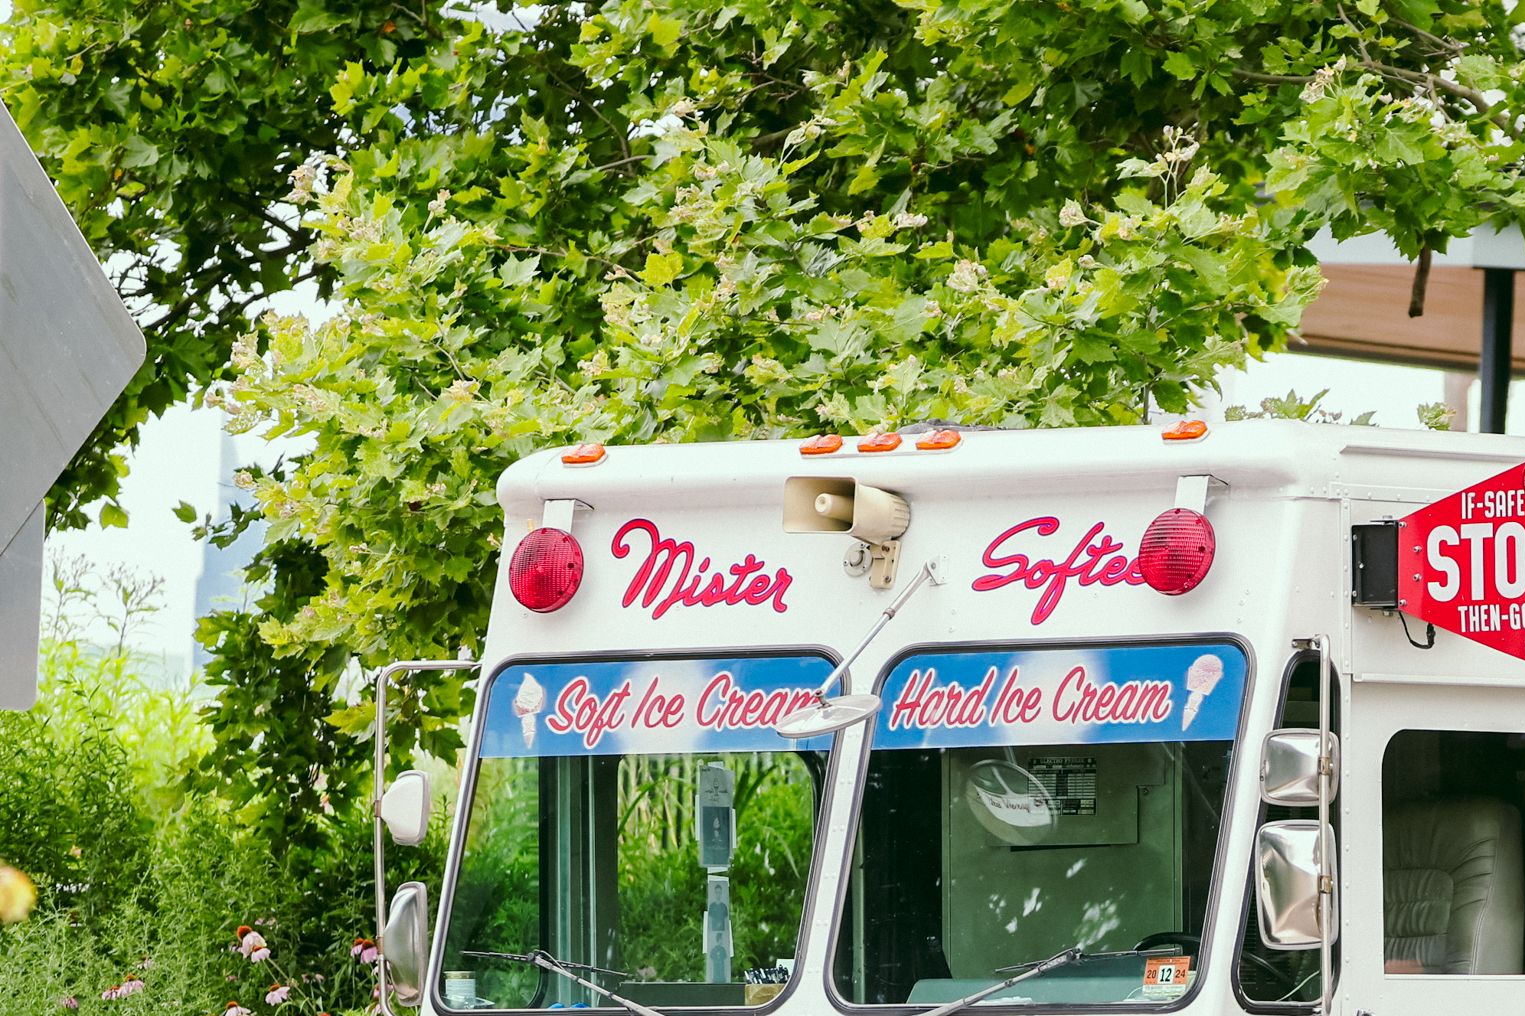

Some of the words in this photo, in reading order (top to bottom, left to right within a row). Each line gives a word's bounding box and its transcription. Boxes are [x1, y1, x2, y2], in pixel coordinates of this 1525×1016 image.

[1461, 490, 1525, 519] IF-SAFE
[611, 518, 794, 620] Mister
[548, 677, 631, 747] Soft
[630, 676, 685, 729] Ice
[889, 667, 997, 730] Hard
[989, 666, 1042, 725] Ice
[1051, 665, 1173, 726] Cream
[1147, 969, 1157, 979] 20
[1160, 967, 1172, 982] 12
[1175, 969, 1186, 979] 24
